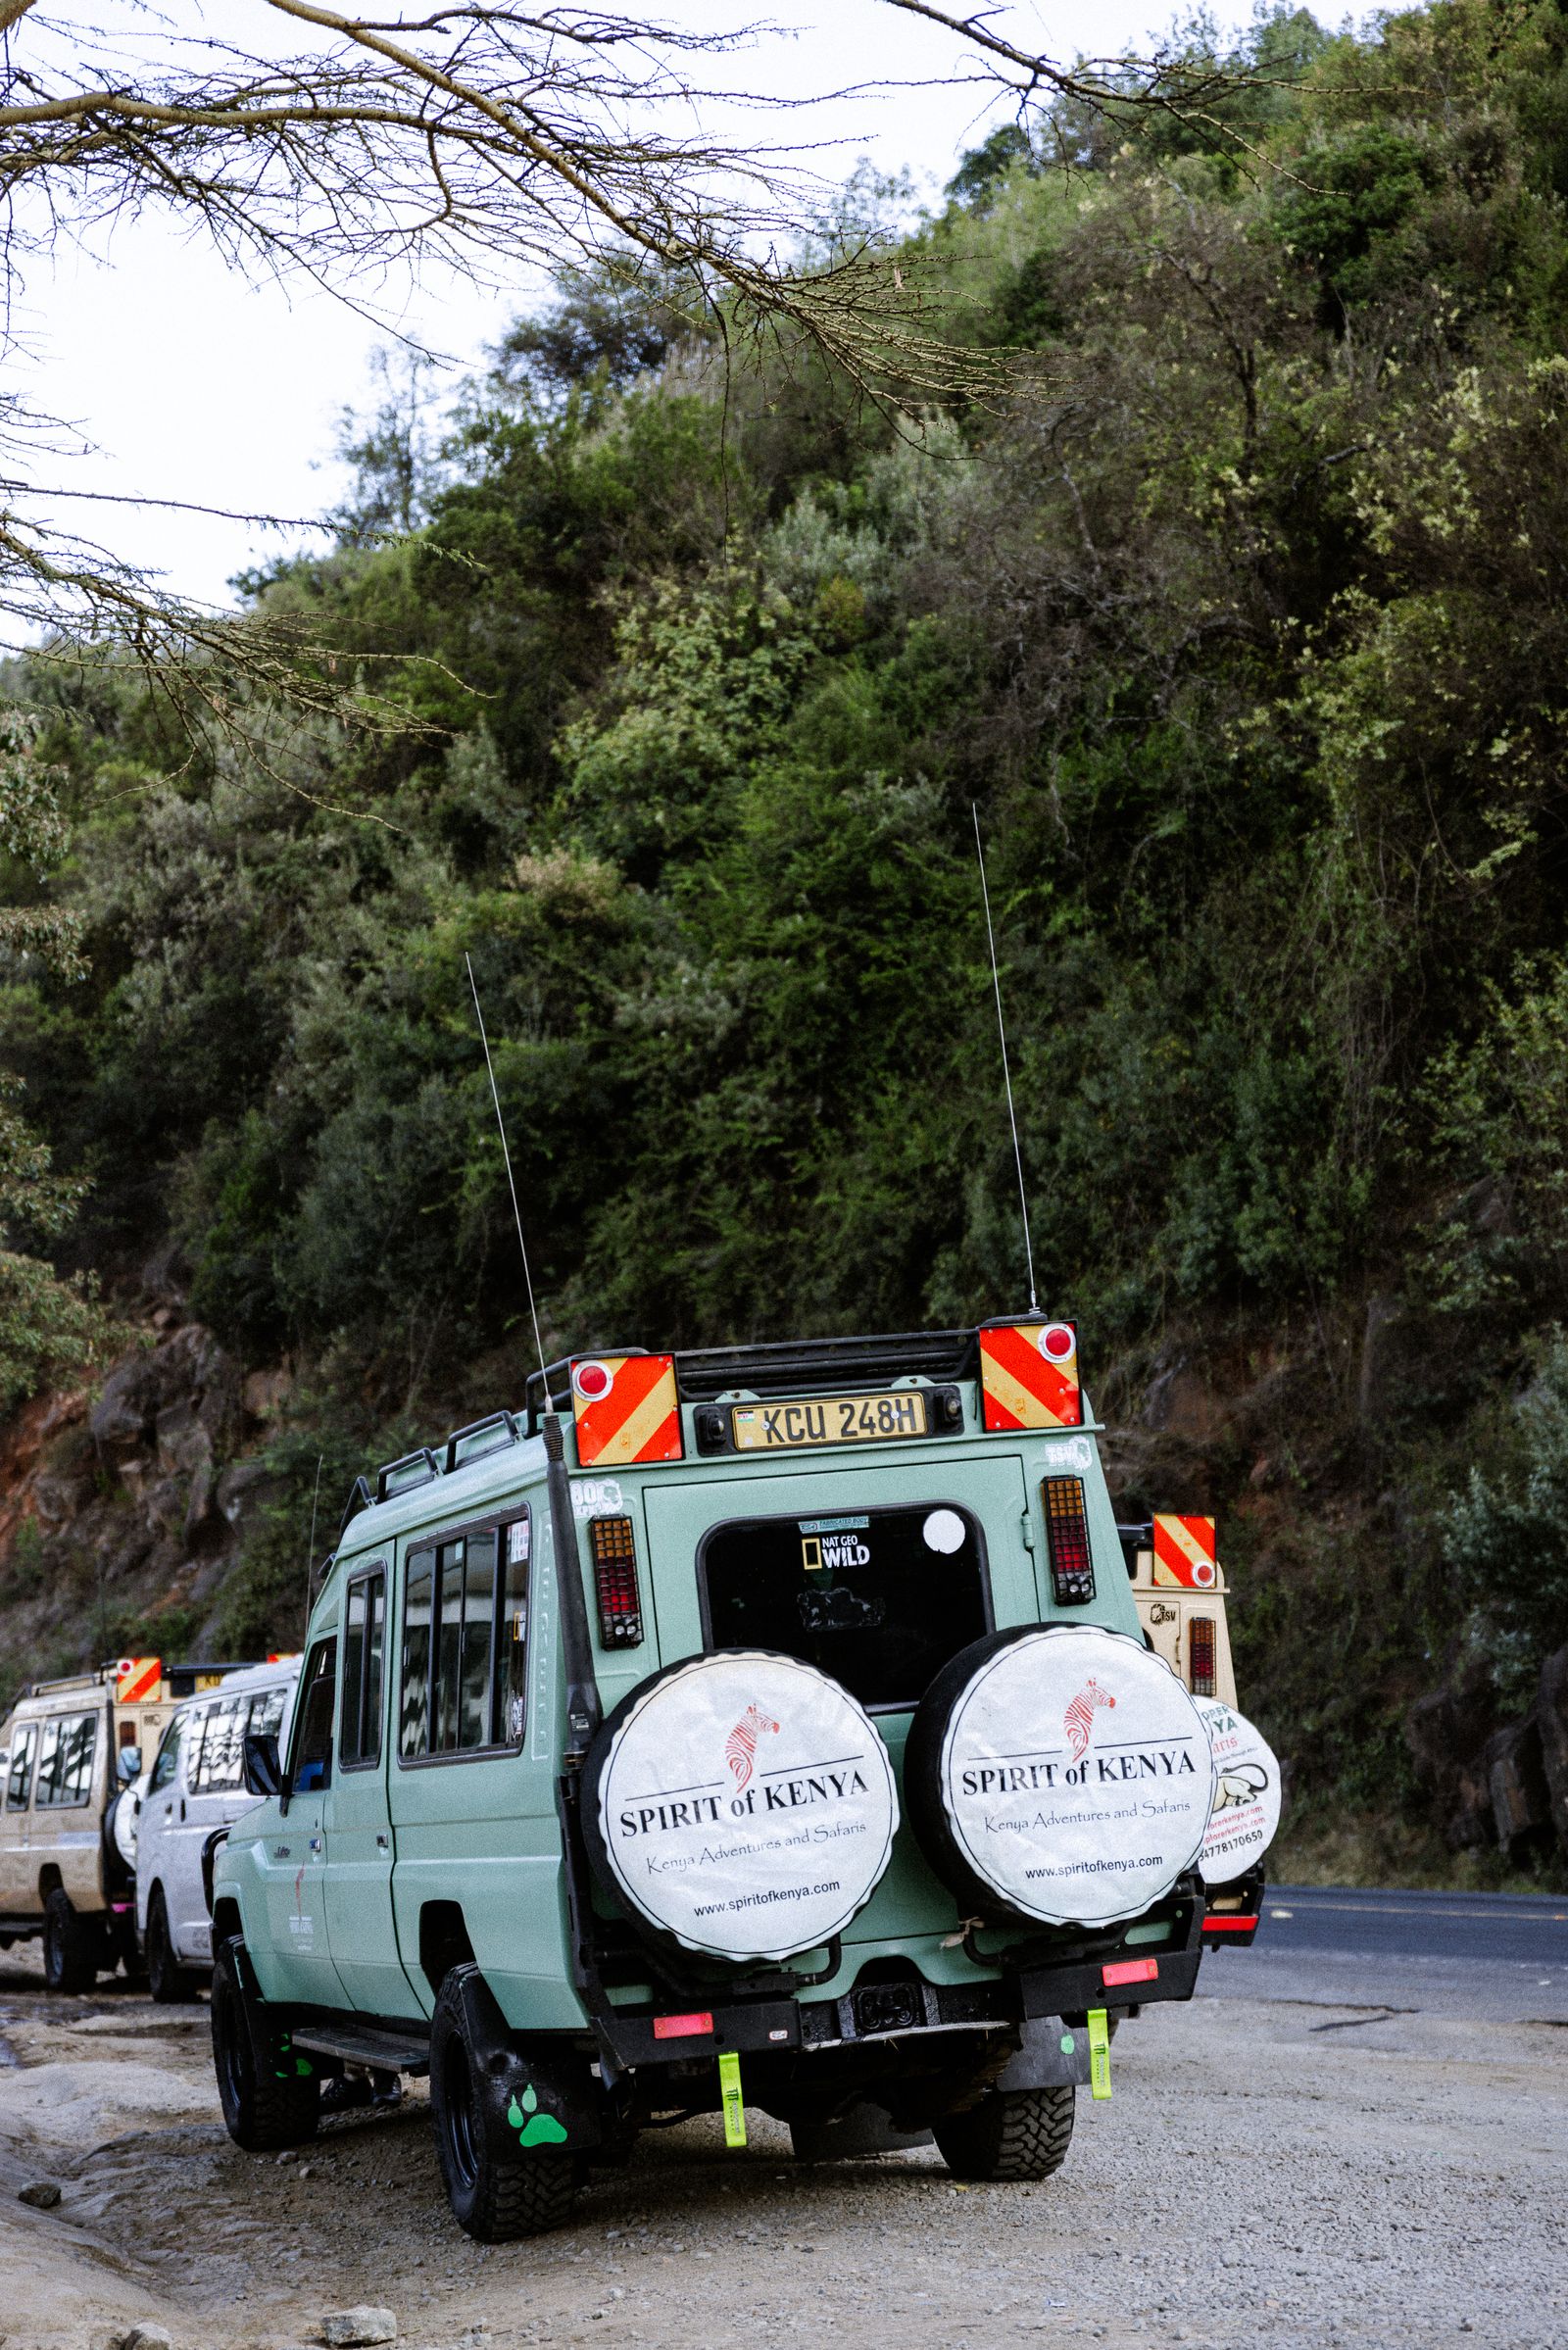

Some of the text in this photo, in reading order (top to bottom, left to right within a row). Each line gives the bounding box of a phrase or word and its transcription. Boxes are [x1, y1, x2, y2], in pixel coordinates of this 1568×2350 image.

[763, 1397, 917, 1444] KCU 248H
[822, 1535, 858, 1548] NAT GEO
[822, 1545, 870, 1569] WILD
[1160, 1610, 1176, 1622] TSV
[1213, 1716, 1239, 1734] YA
[962, 1763, 1058, 1795] SPIRIT
[1065, 1760, 1089, 1786] of
[1098, 1750, 1197, 1783] KENYA
[620, 1770, 870, 1837] SPIRIT of KENYA
[984, 1799, 1191, 1834] Kenya Adventures and Safaris
[646, 1821, 867, 1875] Kenya Adventures and Safaris
[1025, 1855, 1163, 1880] www.spiritofkenya.com
[694, 1880, 841, 1917] www.spiritofkenya.com
